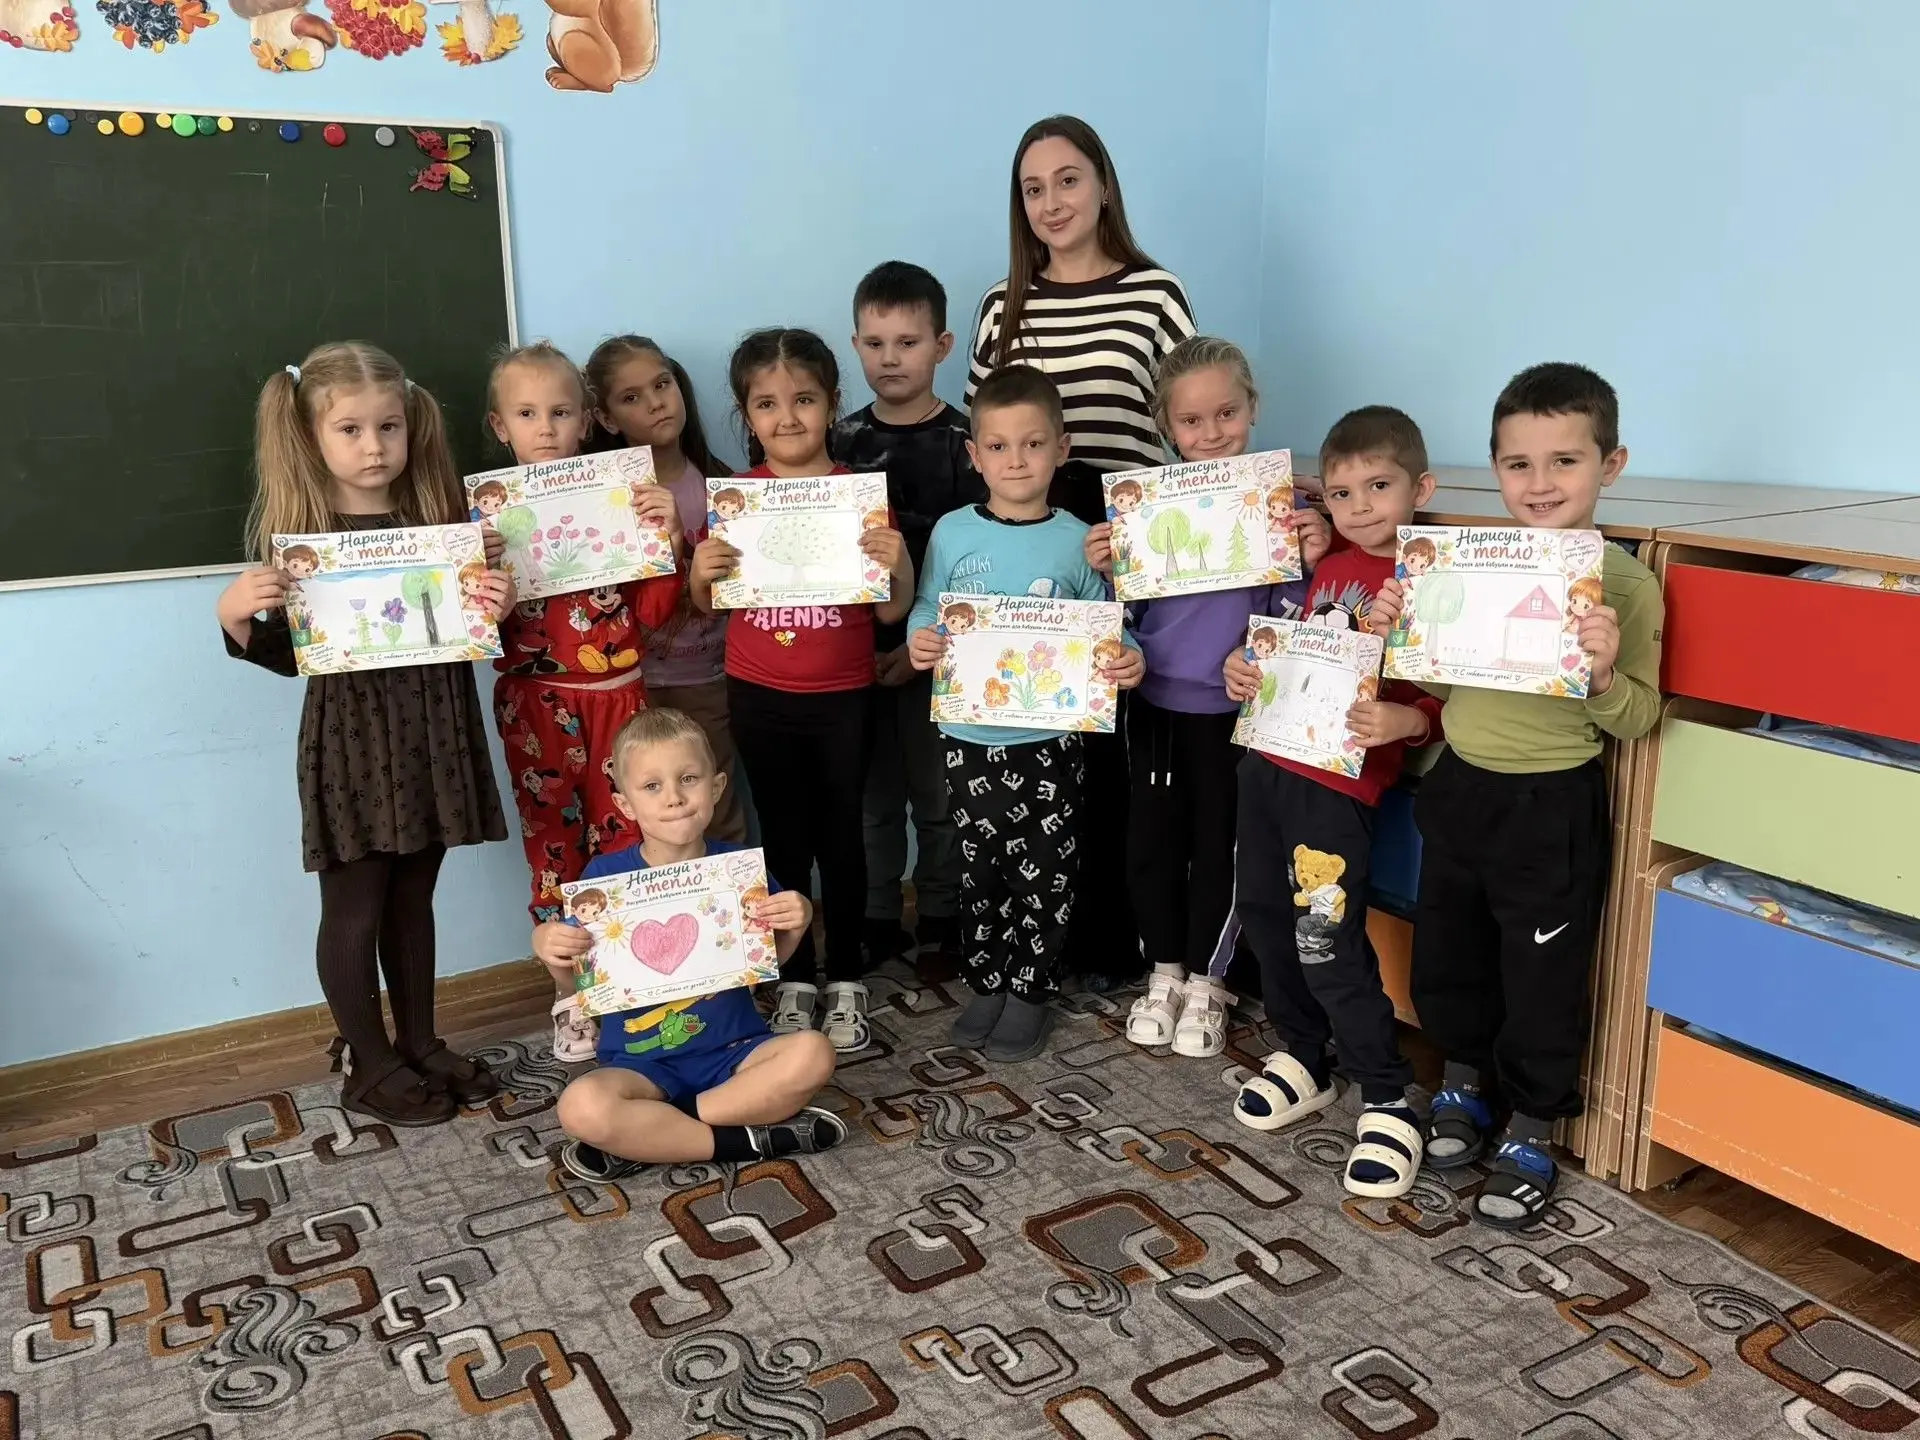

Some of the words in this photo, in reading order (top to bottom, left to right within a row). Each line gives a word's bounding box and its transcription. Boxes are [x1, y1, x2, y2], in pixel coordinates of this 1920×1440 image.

[524, 458, 584, 483] Нарисуй
[542, 469, 595, 489] тепло
[1160, 460, 1219, 483] Нарисуй
[1177, 471, 1230, 489] тепло
[763, 479, 820, 497] Нарисуй
[780, 491, 831, 504] тепло
[338, 531, 405, 552] Нарисуй
[1456, 528, 1522, 548] Нарисуй
[358, 544, 418, 559] тепло
[1474, 546, 1533, 560] тепло
[995, 597, 1054, 613] Нарисуй
[744, 606, 842, 631] FRIENDS
[1011, 612, 1064, 624] тепло
[1291, 622, 1335, 641] Нарисуй
[1299, 639, 1341, 655] тепло
[626, 863, 690, 890] Нарисуй
[645, 873, 702, 895] тепло
